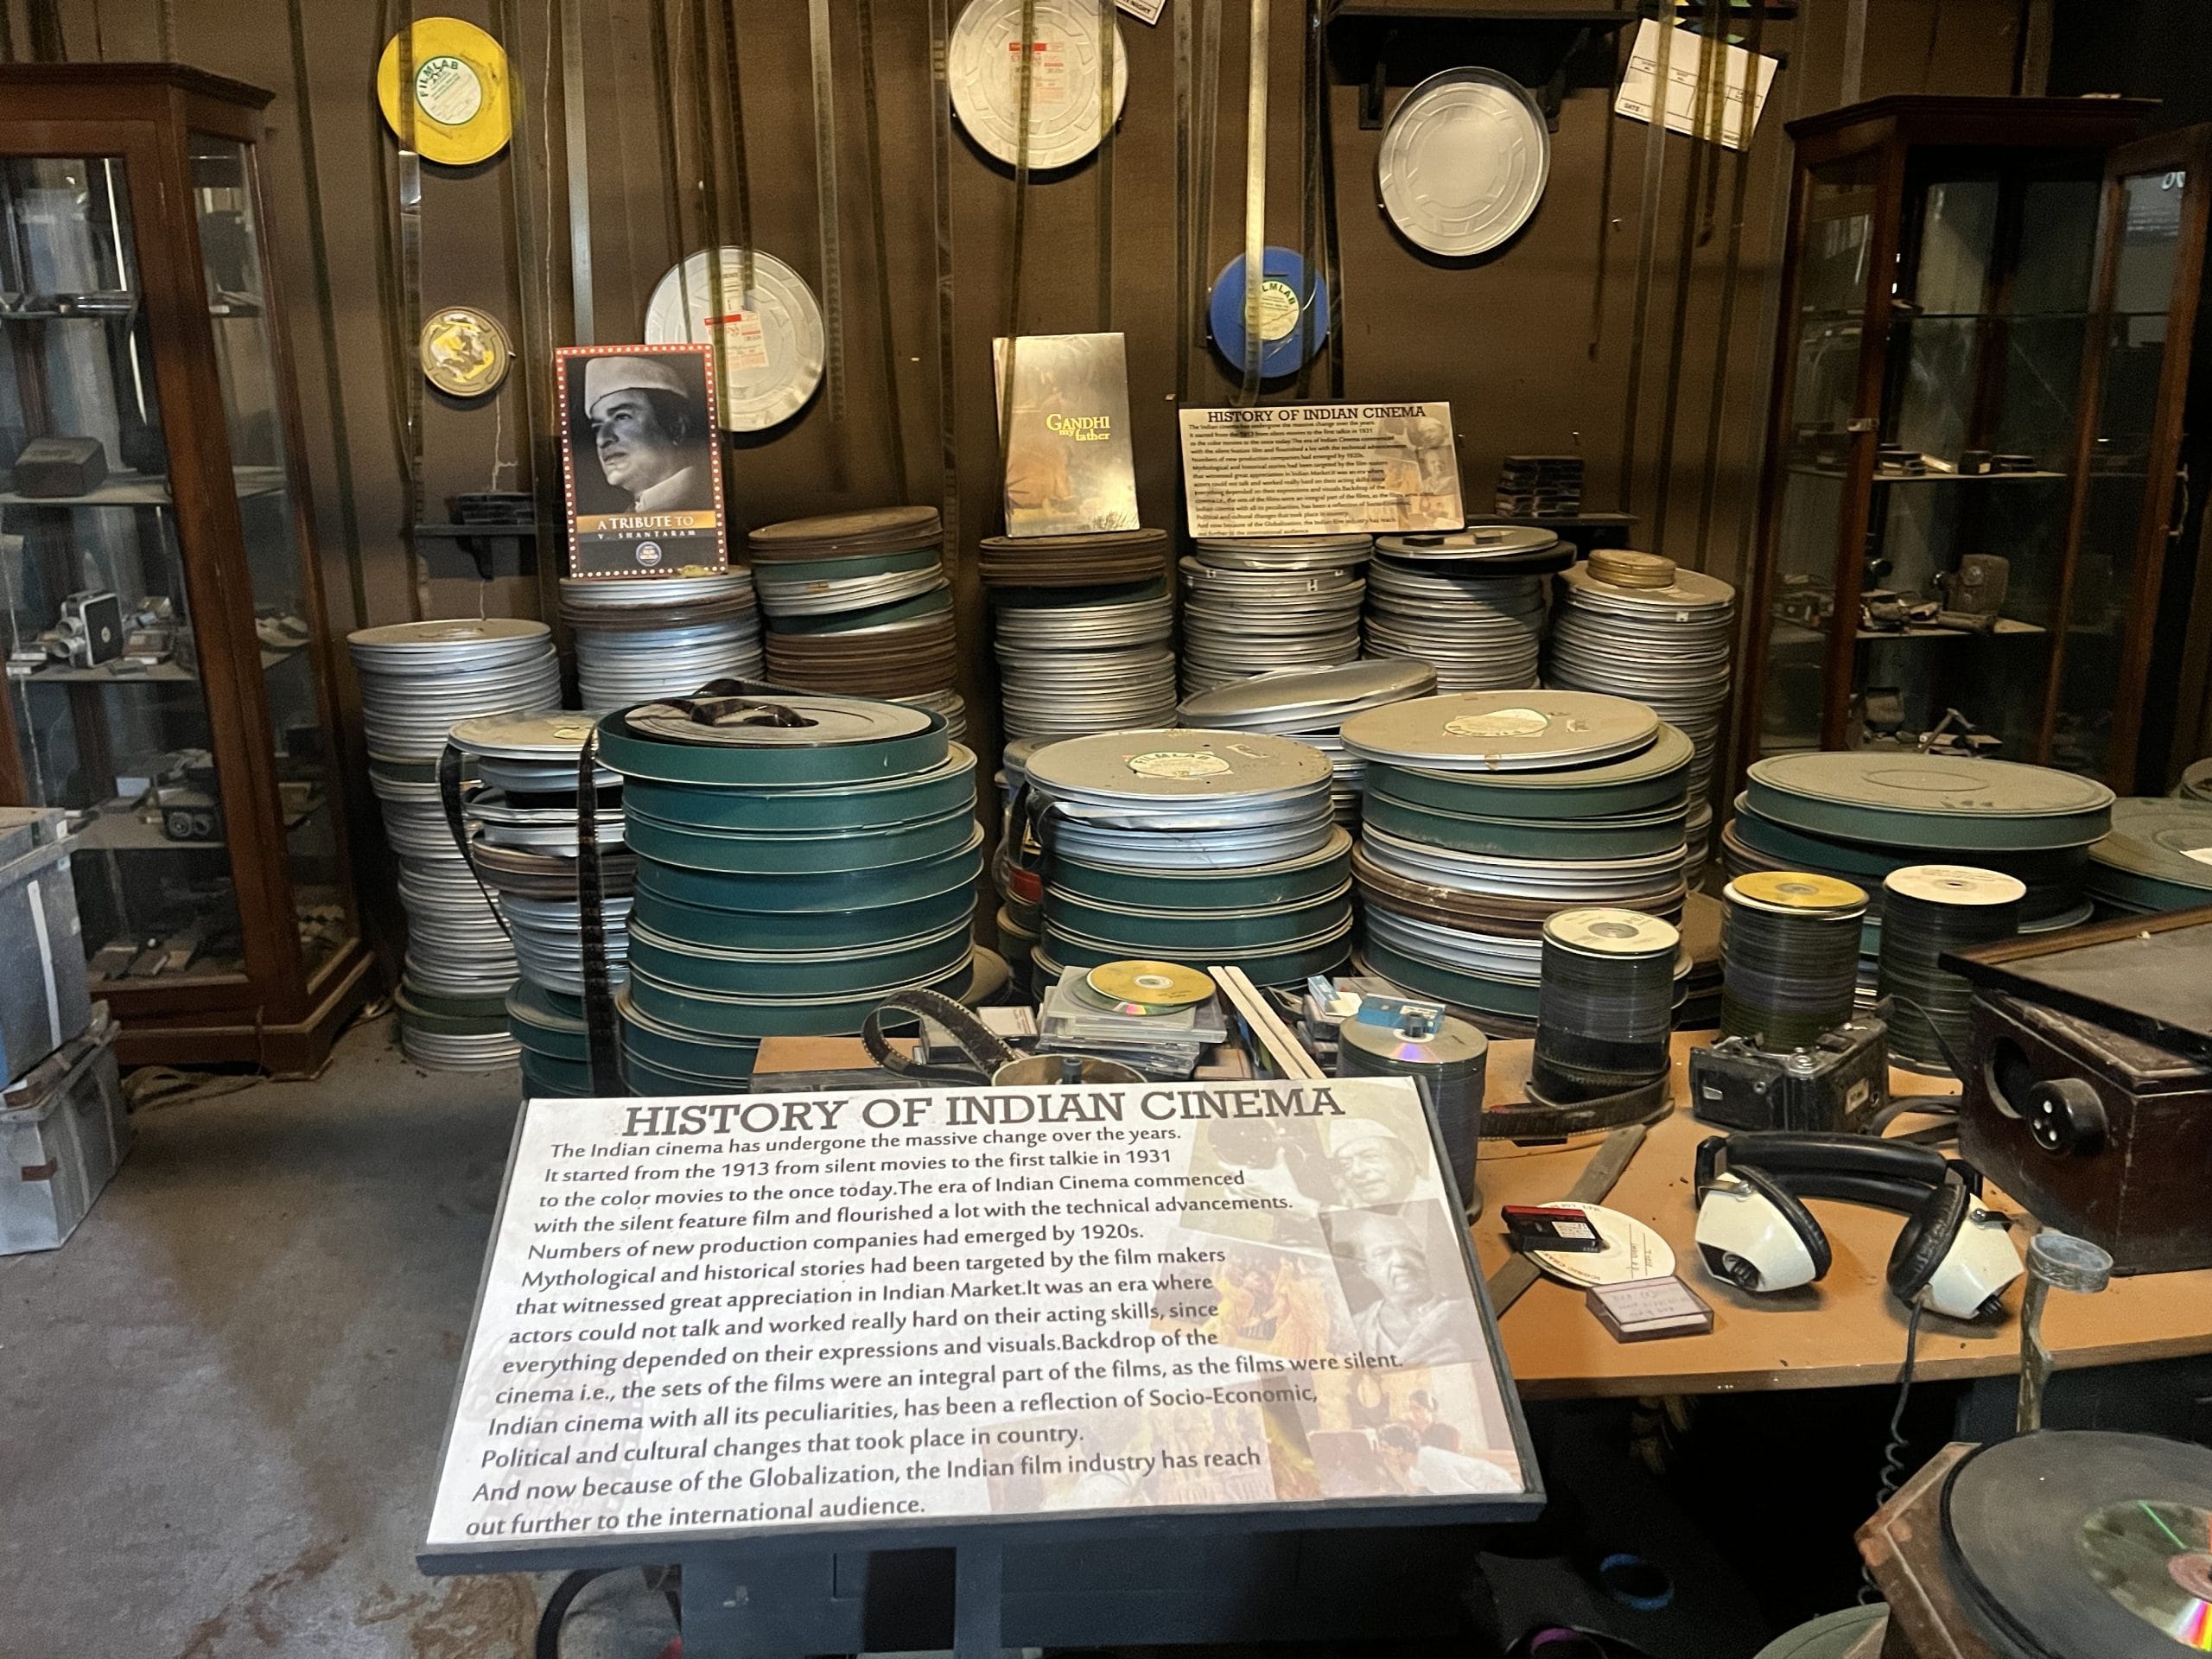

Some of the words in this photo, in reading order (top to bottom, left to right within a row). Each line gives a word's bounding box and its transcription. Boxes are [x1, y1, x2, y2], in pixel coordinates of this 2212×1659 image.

[418, 59, 459, 98] FILMLAB
[1046, 414, 1110, 430] GANDHI
[1208, 410, 1274, 423] HISTORY
[1278, 410, 1300, 421] OF
[1304, 408, 1357, 420] INDIAN
[1363, 406, 1426, 418] CINEMA
[1075, 429, 1110, 441] father
[597, 521, 607, 531] A
[609, 516, 671, 530] TRIBUTE
[673, 516, 694, 527] TO
[619, 531, 696, 539] SHANTARAM
[1135, 753, 1211, 765] FILMLAB
[622, 1100, 848, 1136] HISTORY
[862, 1097, 931, 1128] OF
[946, 1093, 1122, 1125] INDIAN
[1141, 1087, 1345, 1120] CINEMA
[552, 1143, 585, 1157] The
[591, 1142, 649, 1157] Indian
[657, 1142, 723, 1155] cinema
[729, 1139, 760, 1153] has
[766, 1136, 865, 1154] undergone
[872, 1134, 899, 1147] the
[906, 1132, 977, 1146] massive
[983, 1129, 1046, 1147] change
[1052, 1132, 1091, 1141] over
[1096, 1127, 1124, 1141] the
[1129, 1130, 1180, 1145] years.
[545, 1169, 558, 1181] It
[563, 1166, 629, 1181] started
[635, 1166, 678, 1179] from
[686, 1164, 715, 1178] the
[722, 1162, 768, 1176] 1913
[776, 1160, 818, 1174] from
[825, 1158, 875, 1173] silent
[881, 1157, 946, 1171] movies
[952, 1159, 969, 1168] to
[976, 1154, 1003, 1167] the
[1009, 1152, 1045, 1166] first
[1050, 1151, 1098, 1165] talkie
[1104, 1151, 1120, 1164] in
[1126, 1150, 1169, 1163] 1931
[540, 1197, 558, 1206] to
[565, 1192, 594, 1207] the
[601, 1190, 650, 1205] color
[656, 1189, 722, 1204] movies
[730, 1191, 747, 1202] to
[754, 1185, 783, 1200] the
[790, 1188, 834, 1198] once
[840, 1179, 932, 1201] today.The
[938, 1183, 966, 1193] era
[972, 1177, 991, 1192] of
[996, 1176, 1053, 1192] Indian
[1059, 1175, 1128, 1189] Cinema
[1135, 1170, 1244, 1187] commenced
[535, 1217, 576, 1232] with
[584, 1217, 614, 1231] the
[620, 1215, 673, 1230] silent
[679, 1213, 747, 1229] feature
[753, 1210, 789, 1225] film
[796, 1207, 830, 1224] and
[838, 1204, 932, 1222] flourished
[939, 1209, 949, 1219] a
[956, 1203, 979, 1218] lot
[984, 1201, 1025, 1217] with
[1032, 1200, 1060, 1215] the
[1066, 1197, 1148, 1214] technical
[1155, 1197, 1292, 1211] advancements.
[522, 1267, 655, 1292] Mythological
[661, 1265, 698, 1281] and
[705, 1261, 795, 1280] historical
[801, 1261, 864, 1276] stories
[872, 1256, 906, 1274] had
[914, 1256, 959, 1272] been
[966, 1251, 1044, 1274] targeted
[1051, 1251, 1073, 1273] by
[1079, 1250, 1109, 1266] the
[1115, 1249, 1151, 1264] film
[1158, 1247, 1225, 1263] makers
[517, 1298, 557, 1314] that
[563, 1293, 664, 1313] witnessed
[671, 1296, 721, 1315] great
[728, 1288, 851, 1313] appreciation
[859, 1287, 875, 1302] in
[884, 1283, 944, 1300] Indian
[951, 1281, 1040, 1298] Market.It
[1045, 1283, 1083, 1294] was
[1090, 1282, 1111, 1293] an
[1118, 1280, 1147, 1291] era
[1152, 1274, 1212, 1290] where
[503, 1353, 617, 1378] everything
[623, 1347, 727, 1375] depended
[733, 1352, 758, 1363] on
[766, 1344, 813, 1362] their
[819, 1341, 938, 1365] expressions
[944, 1337, 981, 1354] and
[988, 1332, 1155, 1353] visuals.Backdrop
[1162, 1329, 1180, 1346] of
[1187, 1329, 1217, 1345] the
[489, 1416, 557, 1435] Indian
[565, 1415, 642, 1432] cinema
[650, 1408, 696, 1427] with
[704, 1407, 728, 1425] all
[735, 1408, 758, 1424] its
[766, 1402, 898, 1429] peculiarities,
[906, 1399, 939, 1416] has
[947, 1396, 995, 1414] been
[1003, 1401, 1014, 1412] a
[1021, 1392, 1116, 1411] reflection
[1124, 1389, 1144, 1407] of
[1150, 1385, 1317, 1406] Socio-Economic,
[473, 1480, 520, 1501] And
[527, 1485, 576, 1499] now
[583, 1477, 671, 1496] because
[680, 1471, 703, 1491] of
[709, 1470, 741, 1490] the
[750, 1465, 899, 1487] Globalization,
[906, 1461, 939, 1480] the
[948, 1458, 1014, 1478] Indian
[1021, 1455, 1061, 1474] film
[1069, 1453, 1154, 1477] industry
[1162, 1449, 1198, 1468] has
[1205, 1446, 1260, 1466] reach
[467, 1521, 505, 1535] out
[512, 1512, 591, 1533] further
[598, 1516, 619, 1529] to
[627, 1508, 662, 1528] the
[670, 1498, 812, 1525] international
[820, 1497, 924, 1516] audience.
